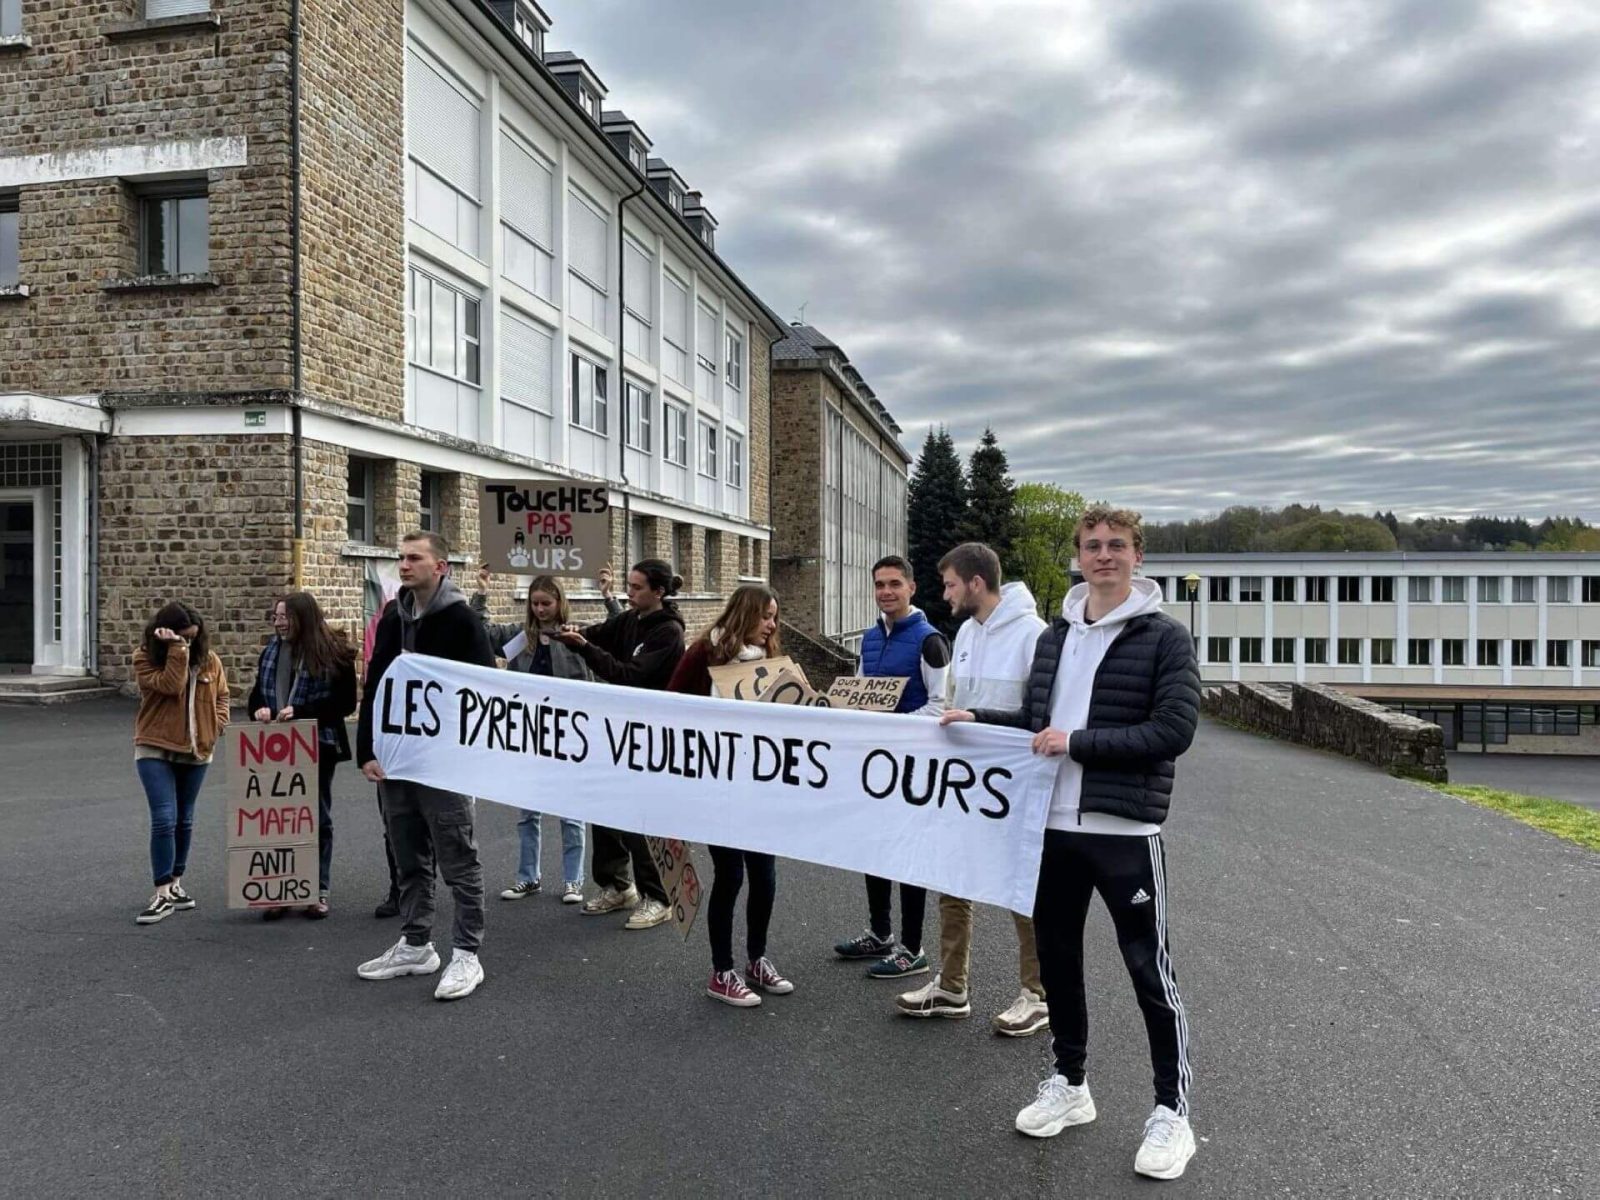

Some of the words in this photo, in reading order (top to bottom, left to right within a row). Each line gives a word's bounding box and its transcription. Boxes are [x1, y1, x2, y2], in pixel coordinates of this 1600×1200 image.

[526, 512, 572, 535] PAS
[539, 534, 574, 545] mon
[240, 725, 318, 767] NON
[381, 678, 443, 737] LES
[455, 687, 589, 763] PYRÉNÉES
[604, 717, 743, 781] VEULENT
[752, 735, 831, 789] DES
[861, 748, 1013, 819] OURS
[246, 769, 261, 799] À
[271, 771, 306, 797] LA
[242, 879, 311, 901] OURS
